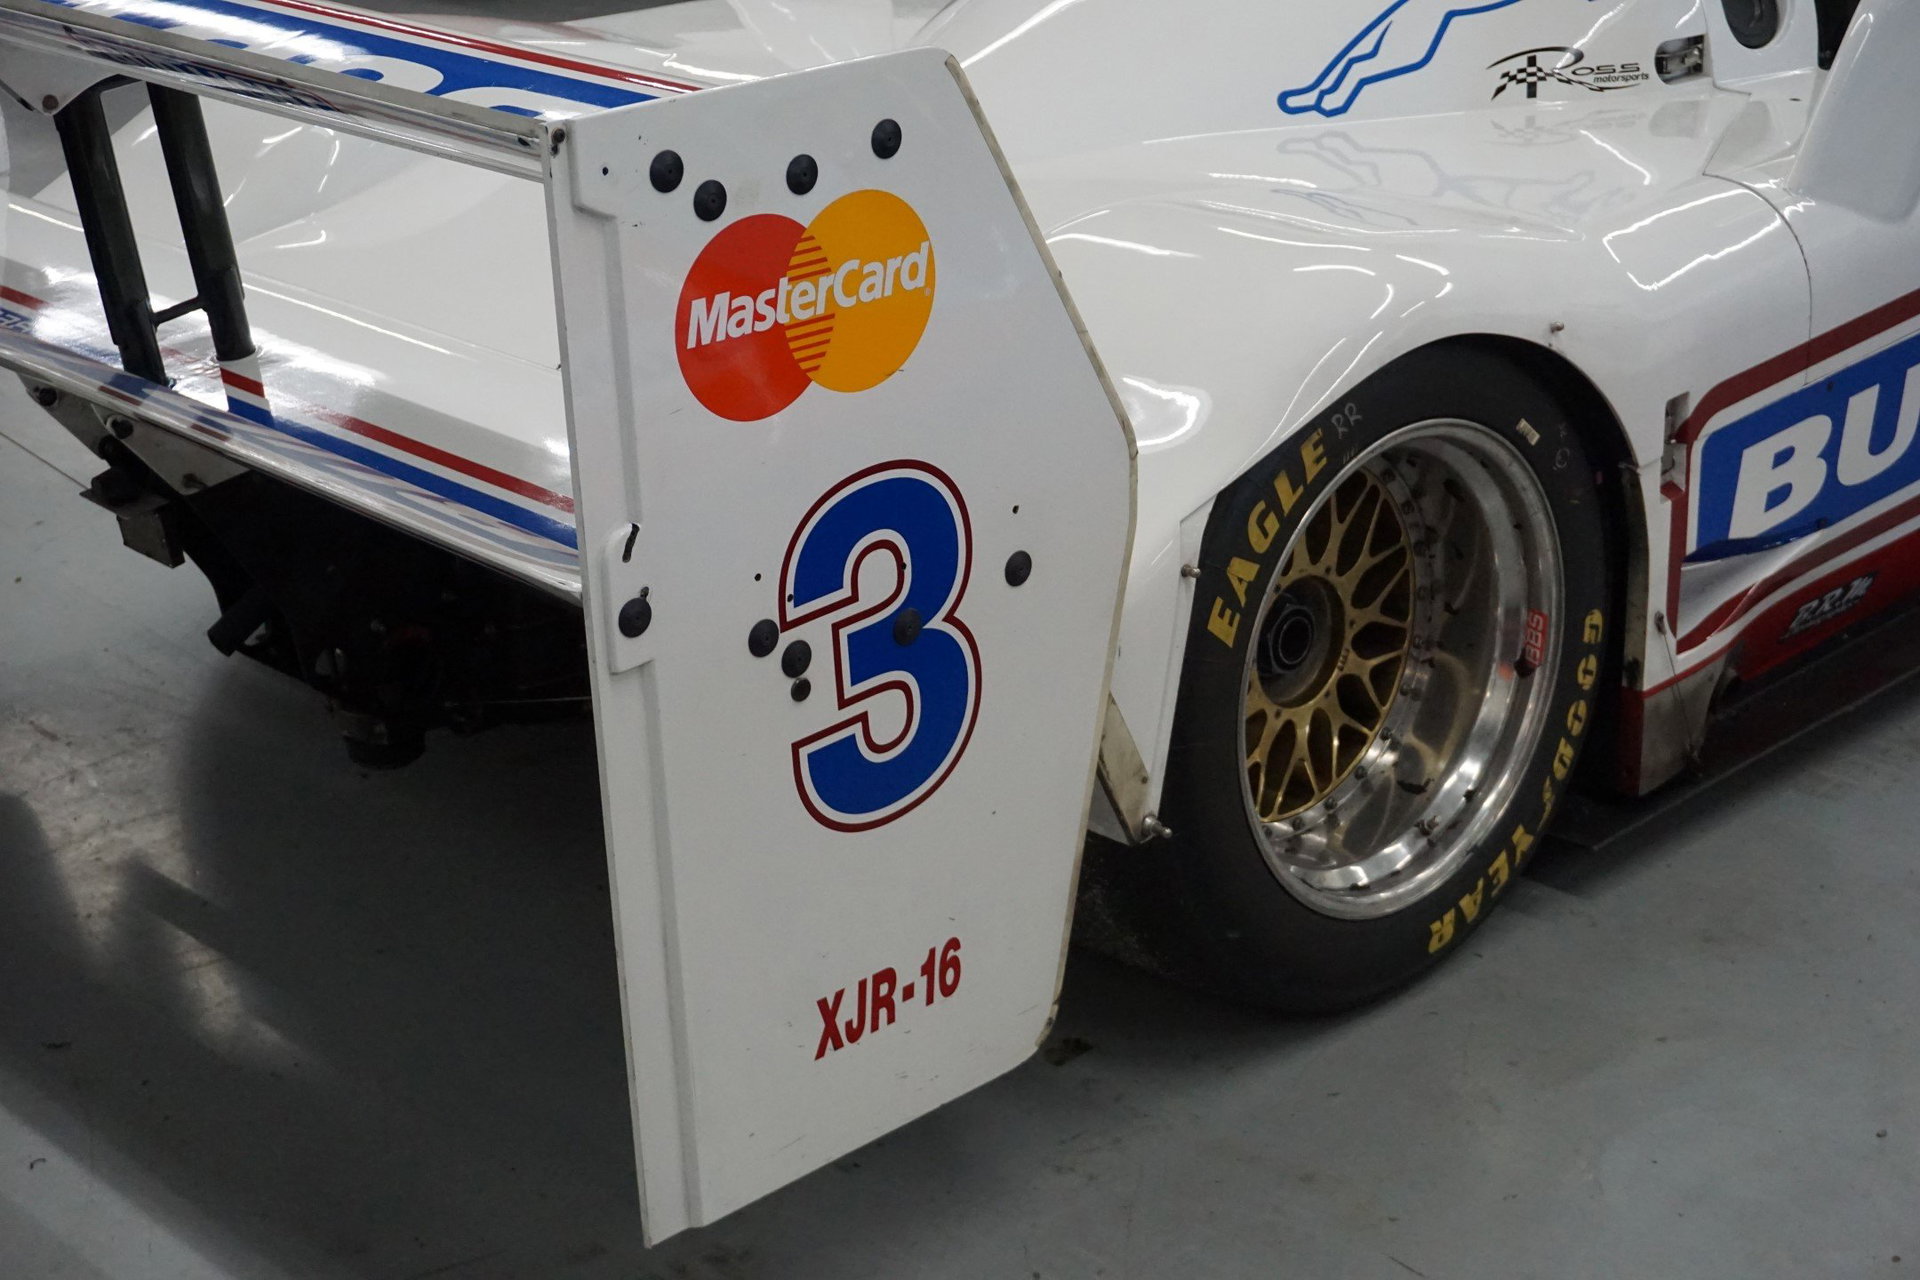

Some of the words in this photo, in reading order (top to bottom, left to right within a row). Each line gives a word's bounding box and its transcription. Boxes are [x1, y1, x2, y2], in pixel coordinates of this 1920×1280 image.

[1593, 72, 1649, 84] motorsports
[687, 240, 930, 350] MasterCard
[1207, 427, 1328, 648] EAGLE
[778, 459, 982, 833] 3
[1525, 611, 1546, 667] BBS
[814, 936, 961, 1062] XJR-16
